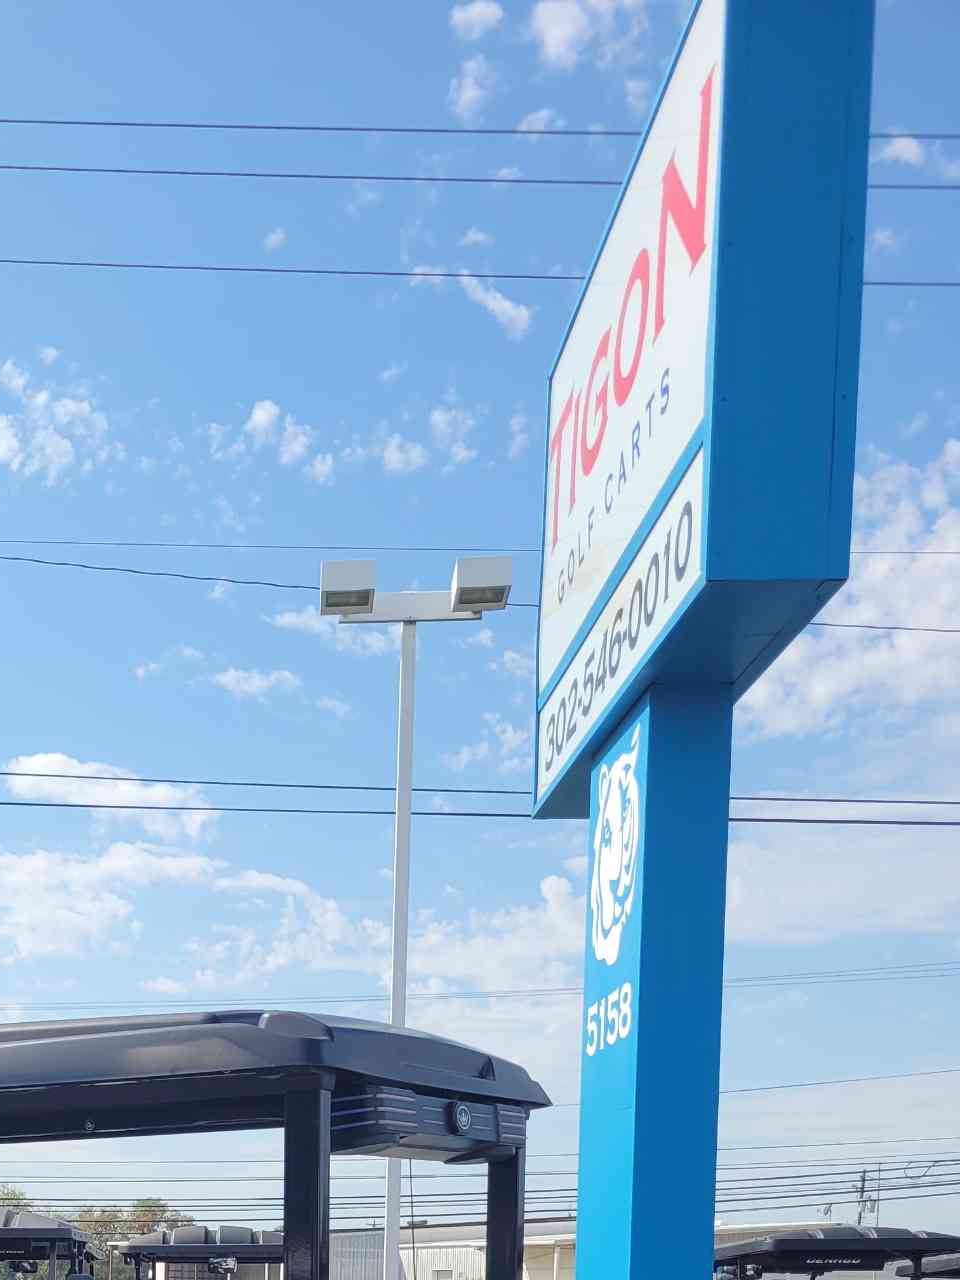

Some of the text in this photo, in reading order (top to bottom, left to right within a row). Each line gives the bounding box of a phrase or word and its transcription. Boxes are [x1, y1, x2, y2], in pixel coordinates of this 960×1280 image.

[550, 62, 717, 556] TIGON
[557, 367, 670, 604] GOLF CARTS
[544, 500, 693, 772] 302-546-0010
[585, 982, 632, 1057] 5158
